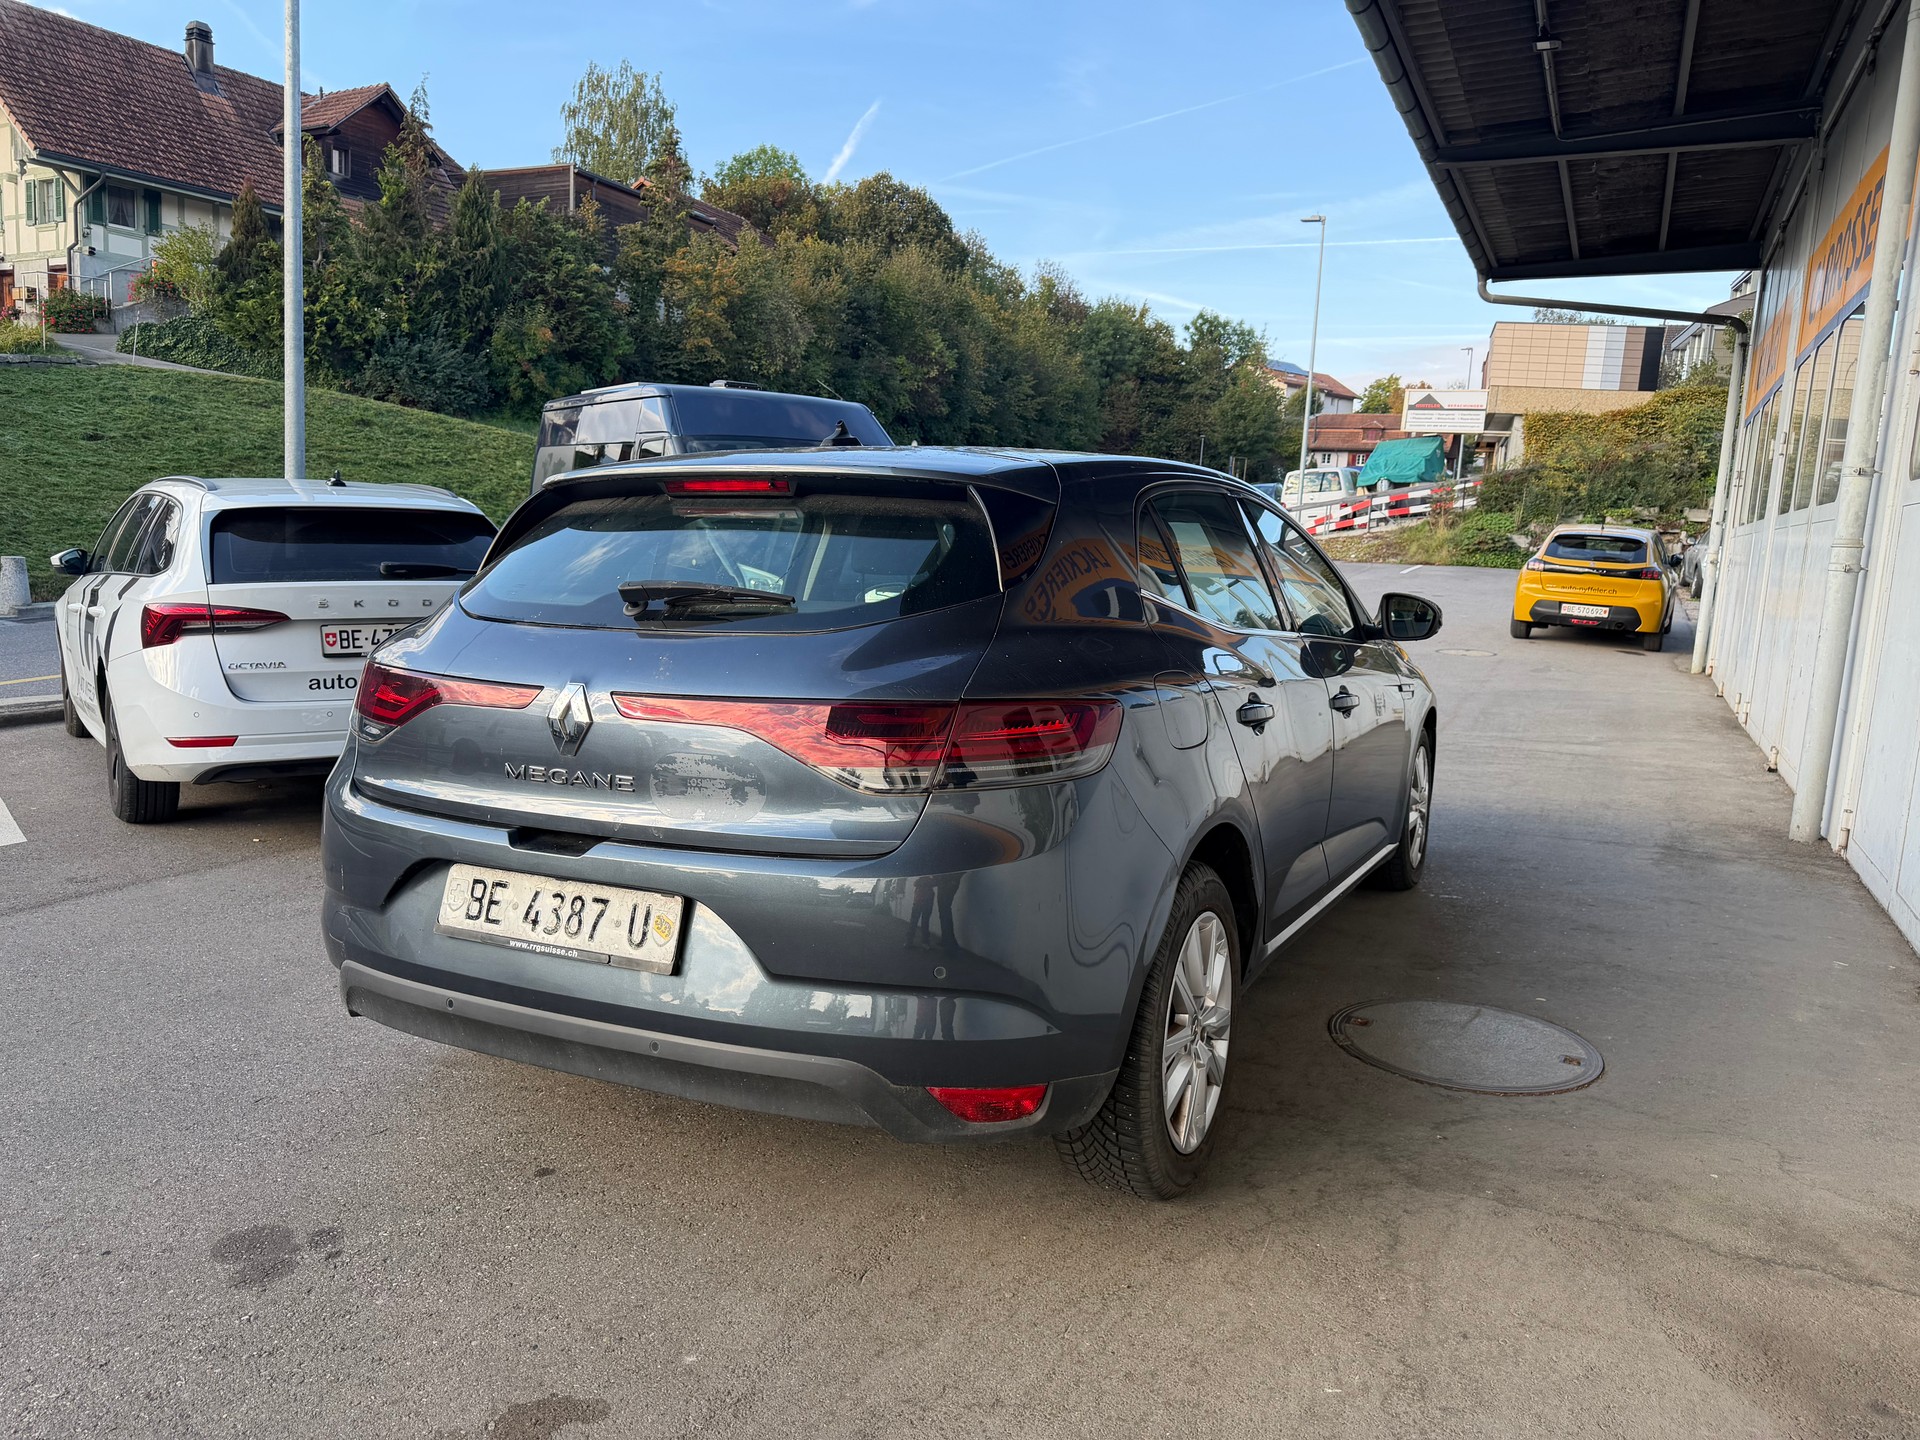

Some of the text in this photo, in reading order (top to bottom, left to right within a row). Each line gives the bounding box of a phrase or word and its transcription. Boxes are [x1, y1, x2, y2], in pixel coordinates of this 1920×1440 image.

[1808, 174, 1887, 326] CARROSSE
[1560, 584, 1618, 595] auto-nyffeler.ch
[228, 661, 287, 670] OCTAVIA
[504, 761, 636, 793] MEGANE
[465, 878, 652, 951] BE 4387 U
[508, 938, 578, 958] www.rrgsuisse.ch
